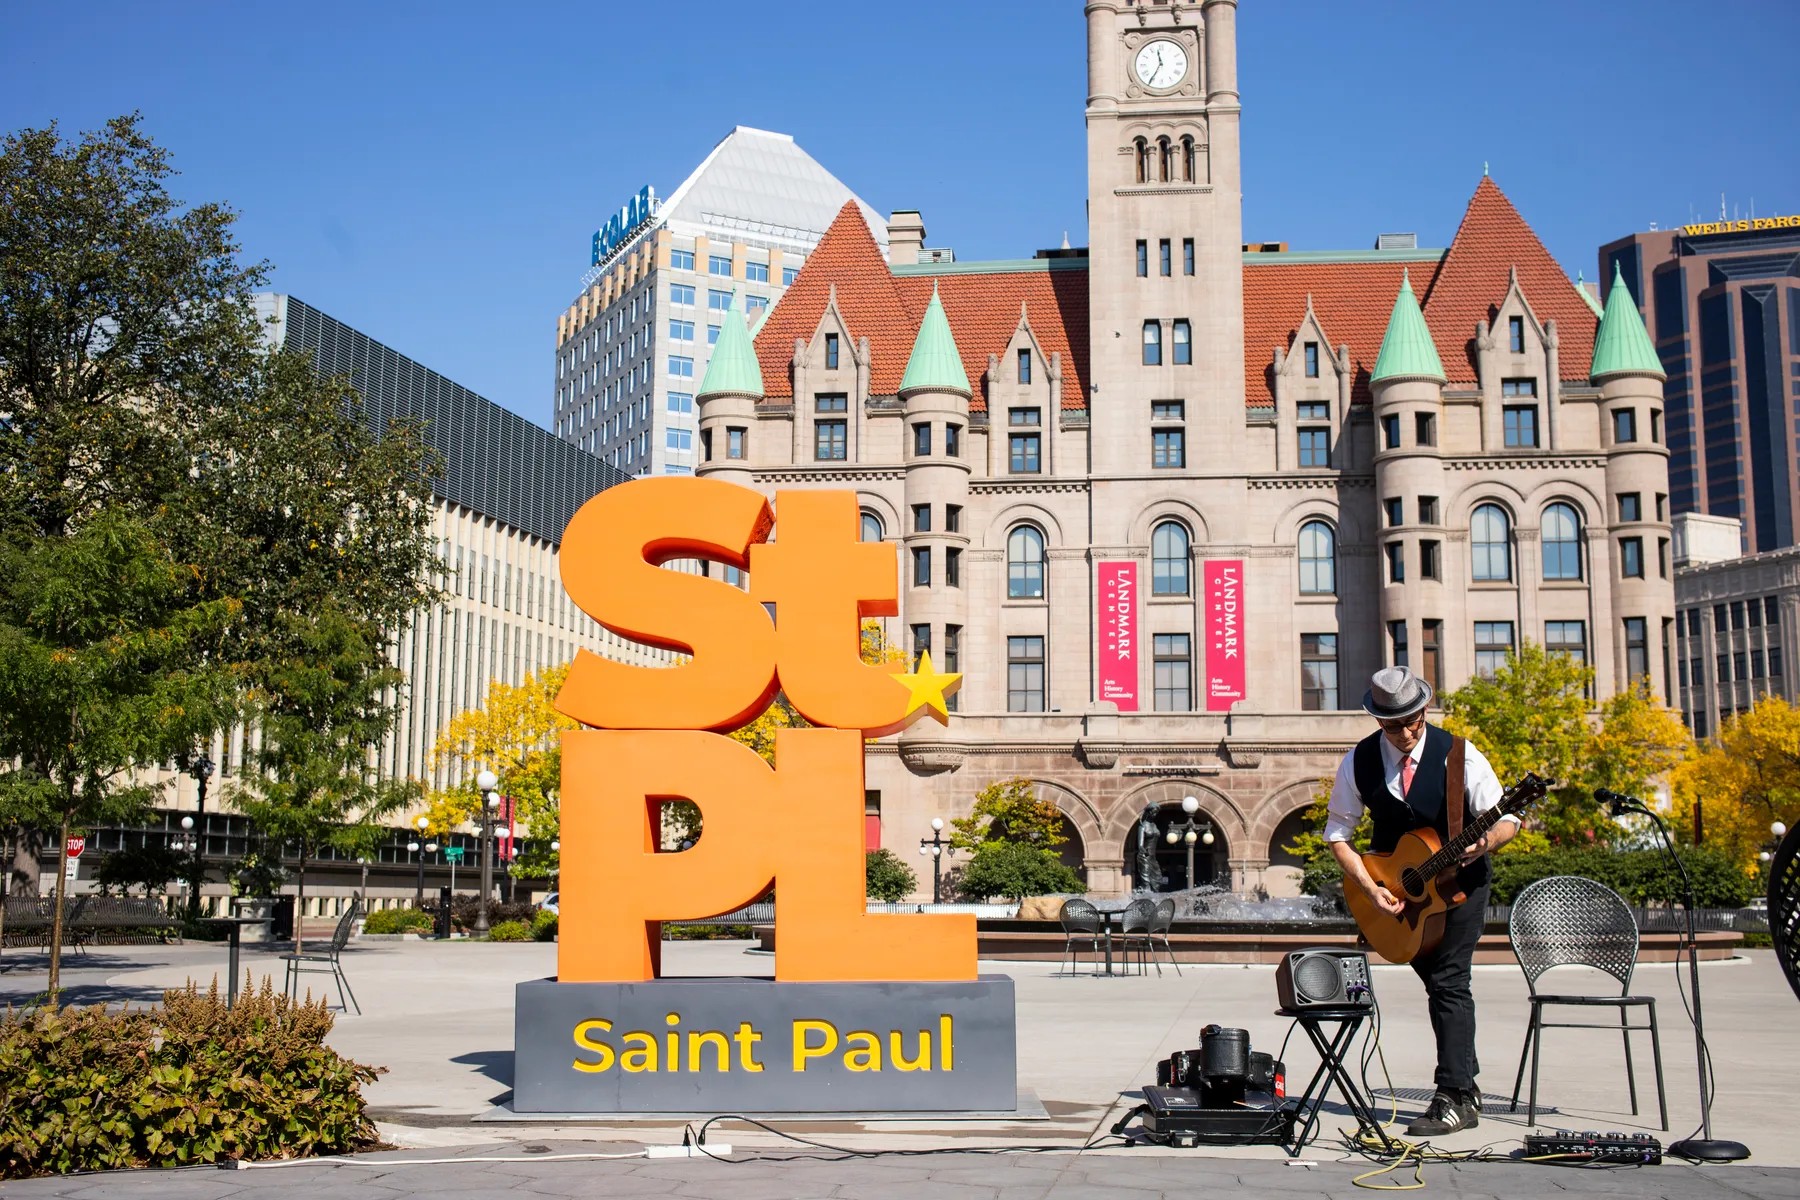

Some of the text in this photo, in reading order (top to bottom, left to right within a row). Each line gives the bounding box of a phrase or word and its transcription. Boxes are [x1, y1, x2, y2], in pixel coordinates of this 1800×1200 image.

[592, 185, 653, 267] ECOLAB
[1684, 220, 1749, 236] WELLS
[555, 476, 912, 738] St
[1107, 579, 1116, 650] CENTER
[1117, 569, 1132, 660] LANDMARK
[1214, 578, 1223, 649] CENTER
[1223, 567, 1239, 660] LANDMARK
[67, 839, 84, 850] STOP
[557, 729, 979, 982] PL
[572, 1013, 954, 1074] Saint Paul
